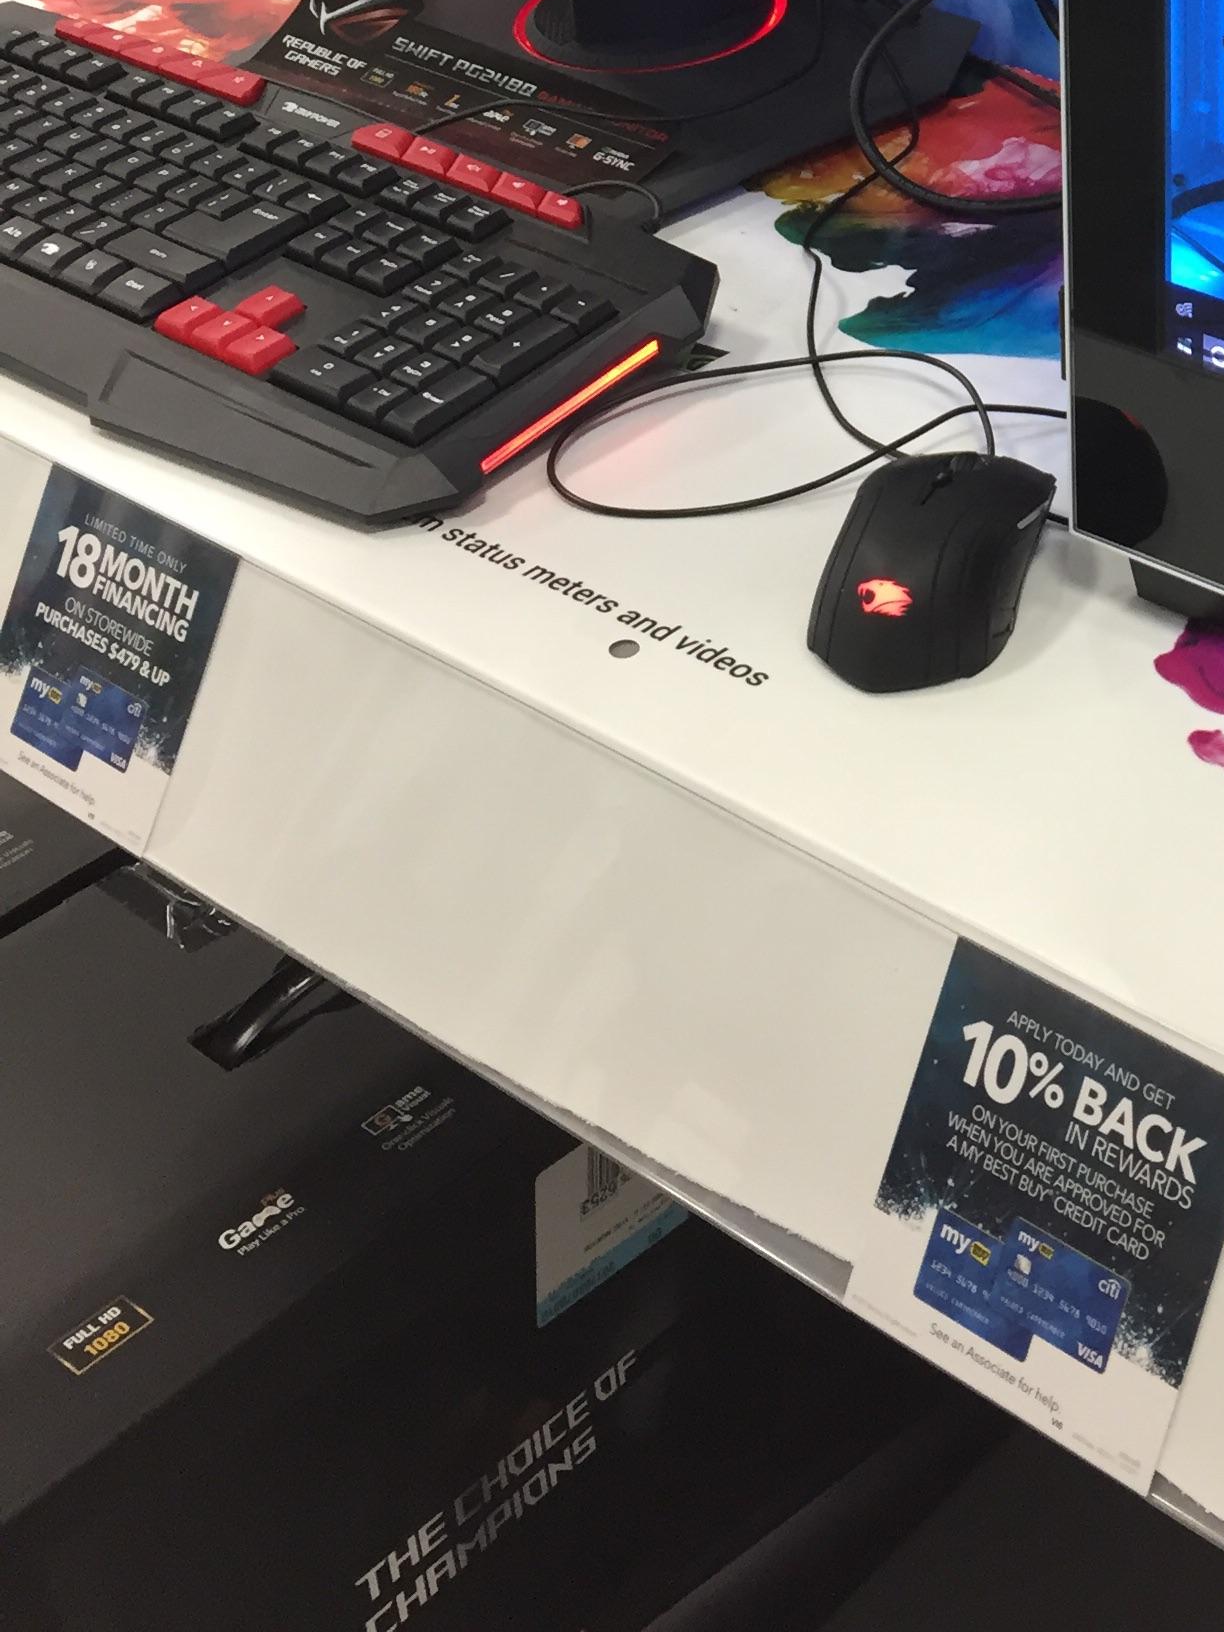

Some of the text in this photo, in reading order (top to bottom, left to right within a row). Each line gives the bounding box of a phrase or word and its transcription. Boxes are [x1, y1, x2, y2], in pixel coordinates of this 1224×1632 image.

[282, 34, 368, 70] REPUBLIC OF
[284, 50, 342, 76] GAMERS
[391, 36, 538, 97] SWIFT PG248Q
[592, 151, 636, 172] G-SYNC
[56, 525, 200, 620] 18 MONTH
[84, 513, 188, 575] LIMITED TIME ONLY
[65, 596, 153, 657] ON STOREWIDE
[92, 574, 190, 643] FINANCING
[441, 527, 770, 687] status meters and videos
[35, 601, 170, 689] PURCHASES $479 & UP
[30, 677, 50, 699] my
[79, 675, 93, 691] my
[110, 751, 127, 769] VISA
[1006, 1010, 1176, 1111] APPLY TODAY AND GET
[961, 1019, 1208, 1185] 10% BACK
[947, 1111, 1167, 1249] WHEN YOU ARE APPROVED FOR
[971, 1104, 1155, 1219] ON YOUR FIRST PURCHASE
[1064, 1121, 1195, 1211] IN REWARDS
[945, 1135, 960, 1152] A
[959, 1141, 985, 1167] MY
[981, 1153, 1021, 1187] BEST
[1053, 1193, 1108, 1235] CREDIT
[1106, 1226, 1150, 1261] CARD
[939, 1223, 972, 1255] my
[1018, 1230, 1040, 1252] my
[1098, 1278, 1121, 1300] citi
[62, 1305, 122, 1352] FULL HD
[83, 1321, 131, 1356] 1080
[929, 1322, 950, 1345] See
[951, 1336, 966, 1353] an
[965, 1344, 1017, 1386] Associate
[1017, 1377, 1036, 1395] for
[1076, 1342, 1104, 1369] VISA
[354, 1349, 638, 1601] THE CHOICE OF
[365, 1426, 597, 1632] CHAMPIONS
